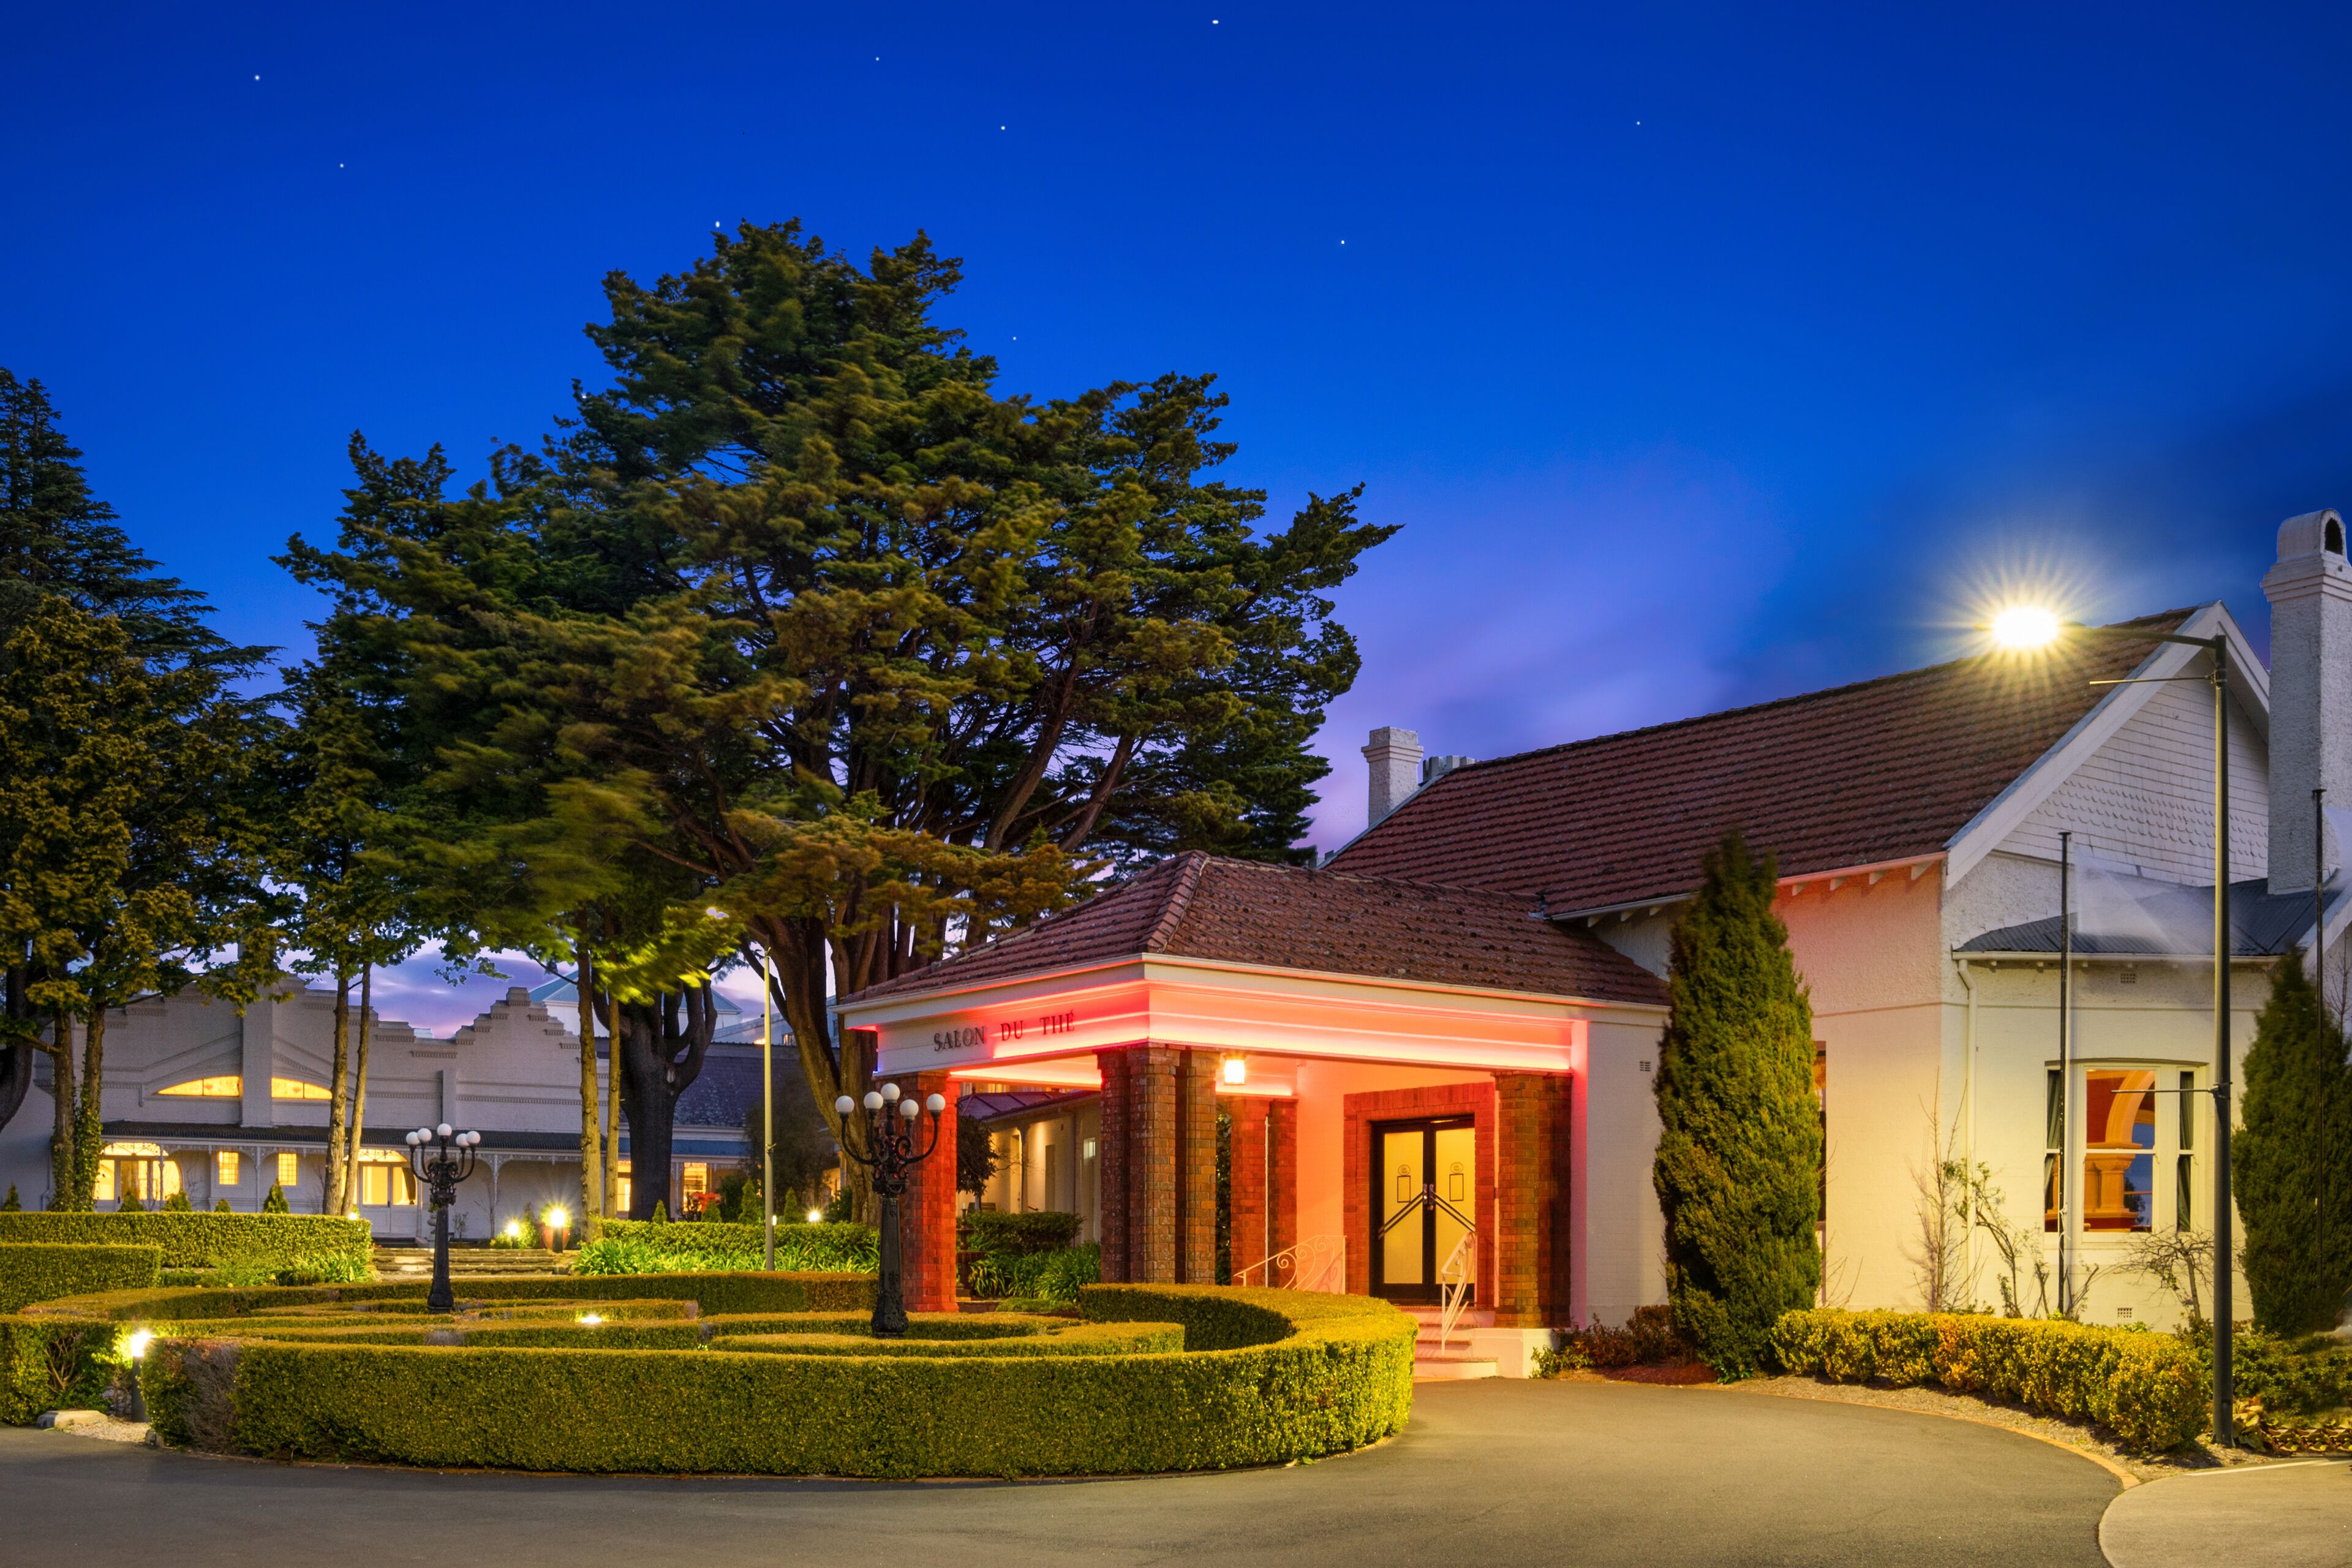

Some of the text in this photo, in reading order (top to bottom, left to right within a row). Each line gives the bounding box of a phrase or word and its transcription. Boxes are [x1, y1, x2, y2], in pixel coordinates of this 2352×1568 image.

[933, 1009, 1074, 1052] SALON DU THÉ
